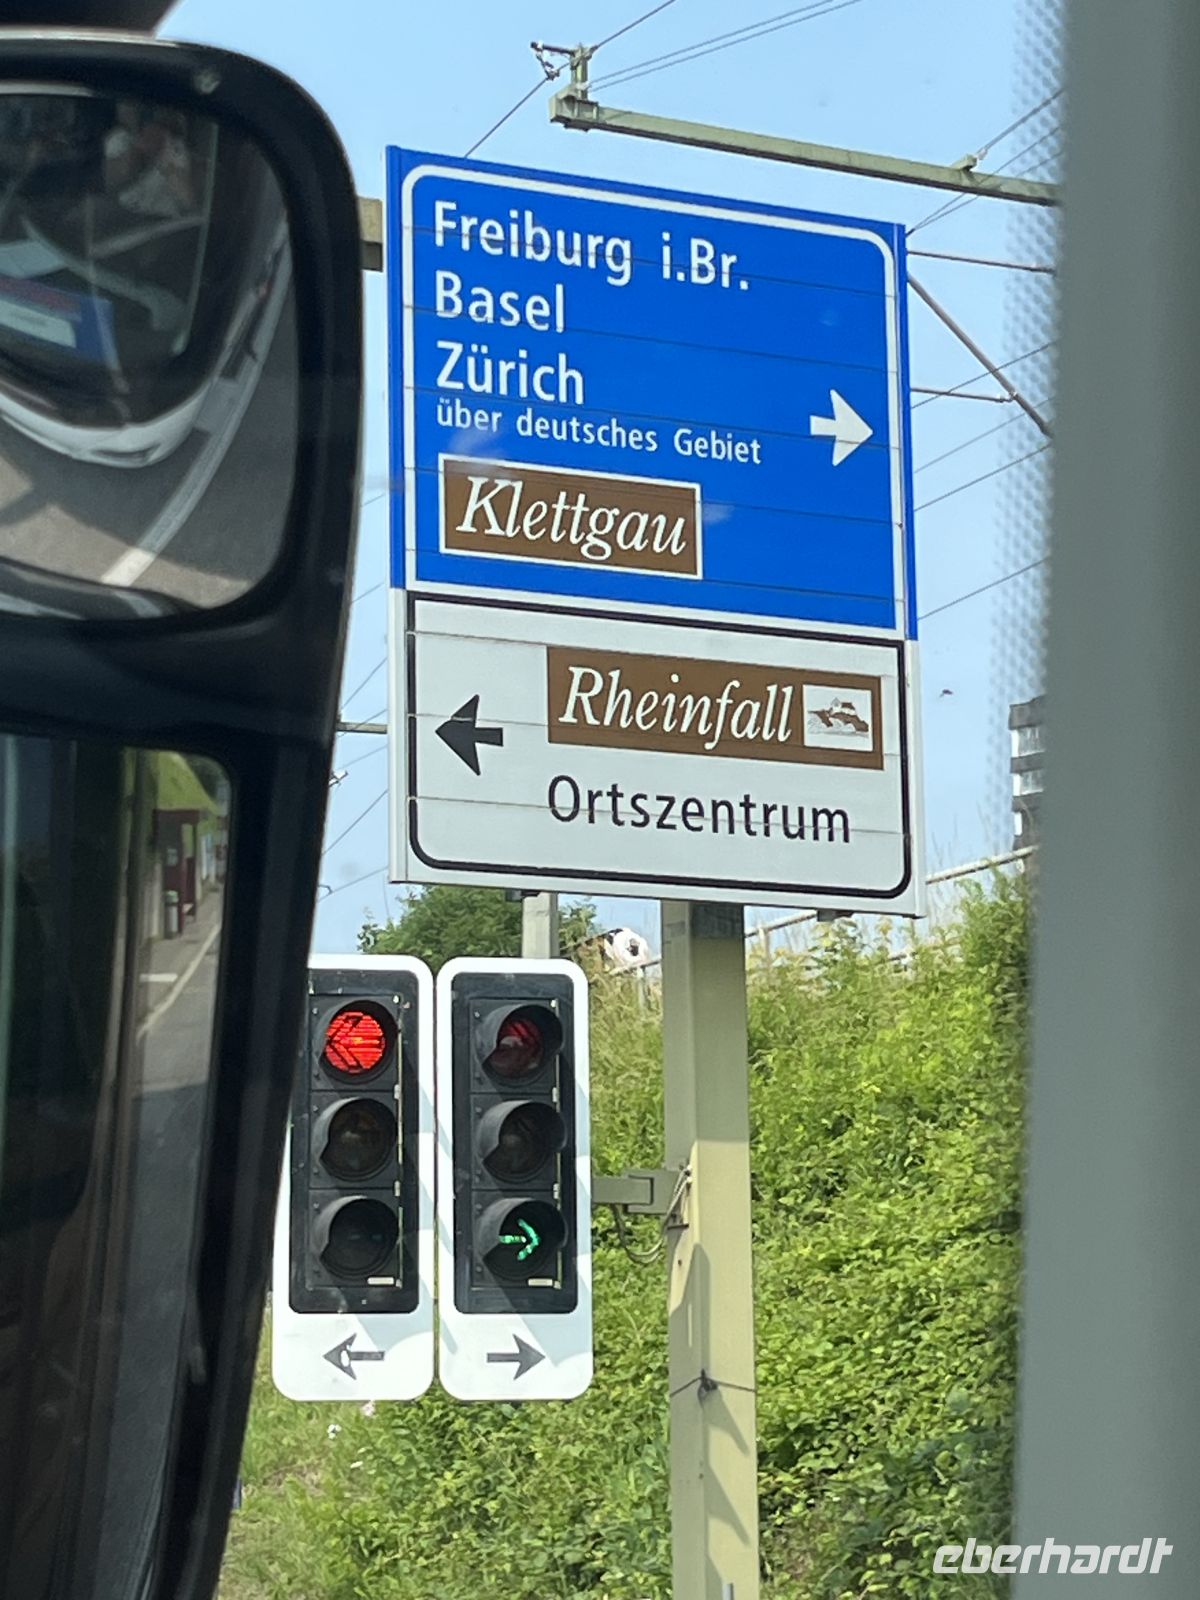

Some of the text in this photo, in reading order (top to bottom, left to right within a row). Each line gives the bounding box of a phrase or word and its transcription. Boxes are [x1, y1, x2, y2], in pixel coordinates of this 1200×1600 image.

[434, 201, 750, 290] Freiburg i.Br.
[434, 270, 565, 333] Basel
[436, 340, 585, 405] Zürich
[436, 397, 762, 465] über deutsches Gebiet
[456, 475, 687, 560] Klettgau
[558, 665, 796, 750] Rheinfall
[548, 774, 851, 844] Ortszentrum
